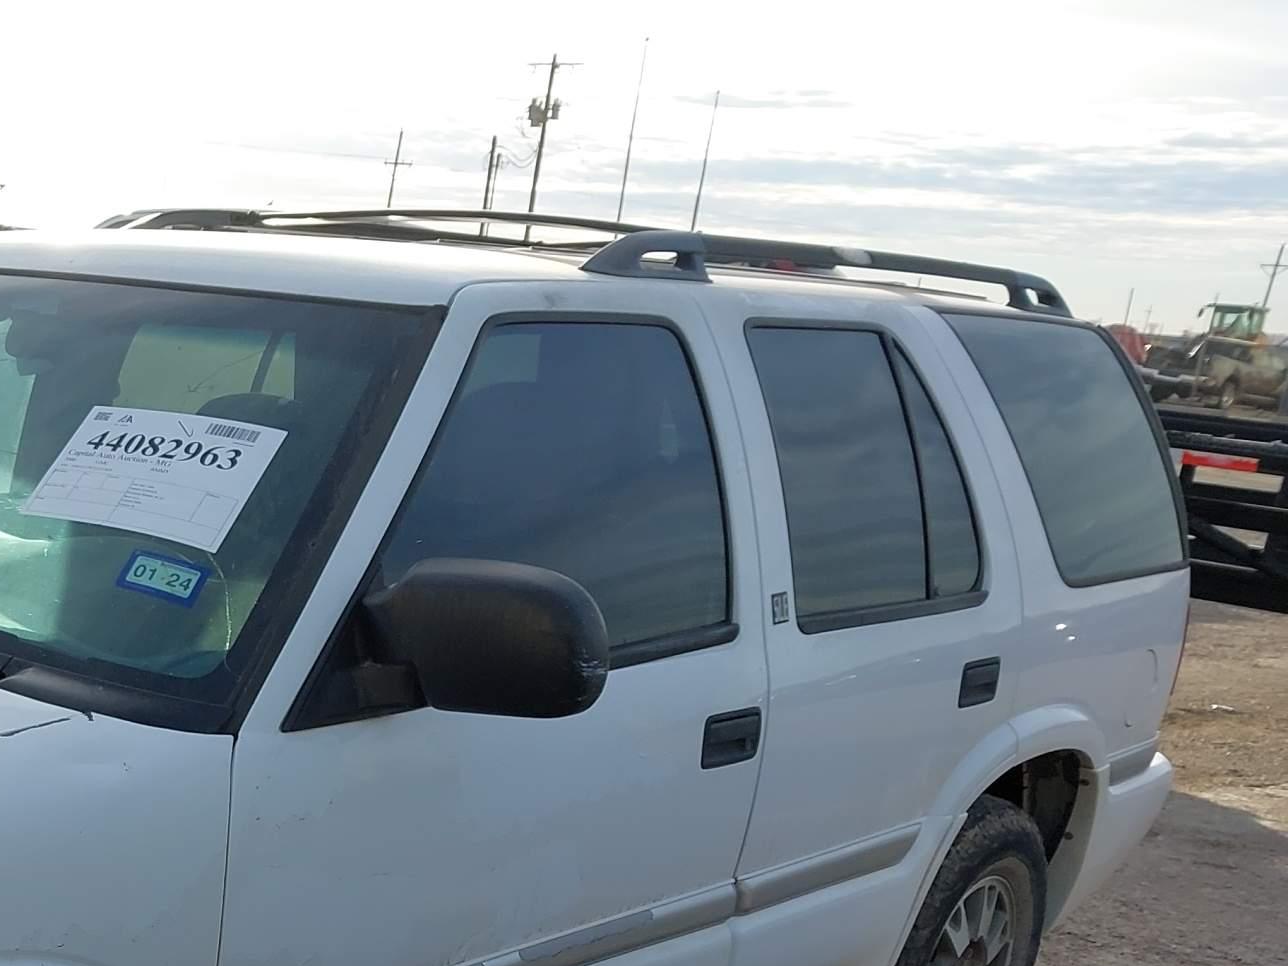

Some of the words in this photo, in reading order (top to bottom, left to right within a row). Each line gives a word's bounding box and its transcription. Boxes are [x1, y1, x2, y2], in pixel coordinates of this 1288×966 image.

[86, 430, 243, 471] 44082963
[133, 563, 158, 581] 01
[165, 573, 192, 592] 24
